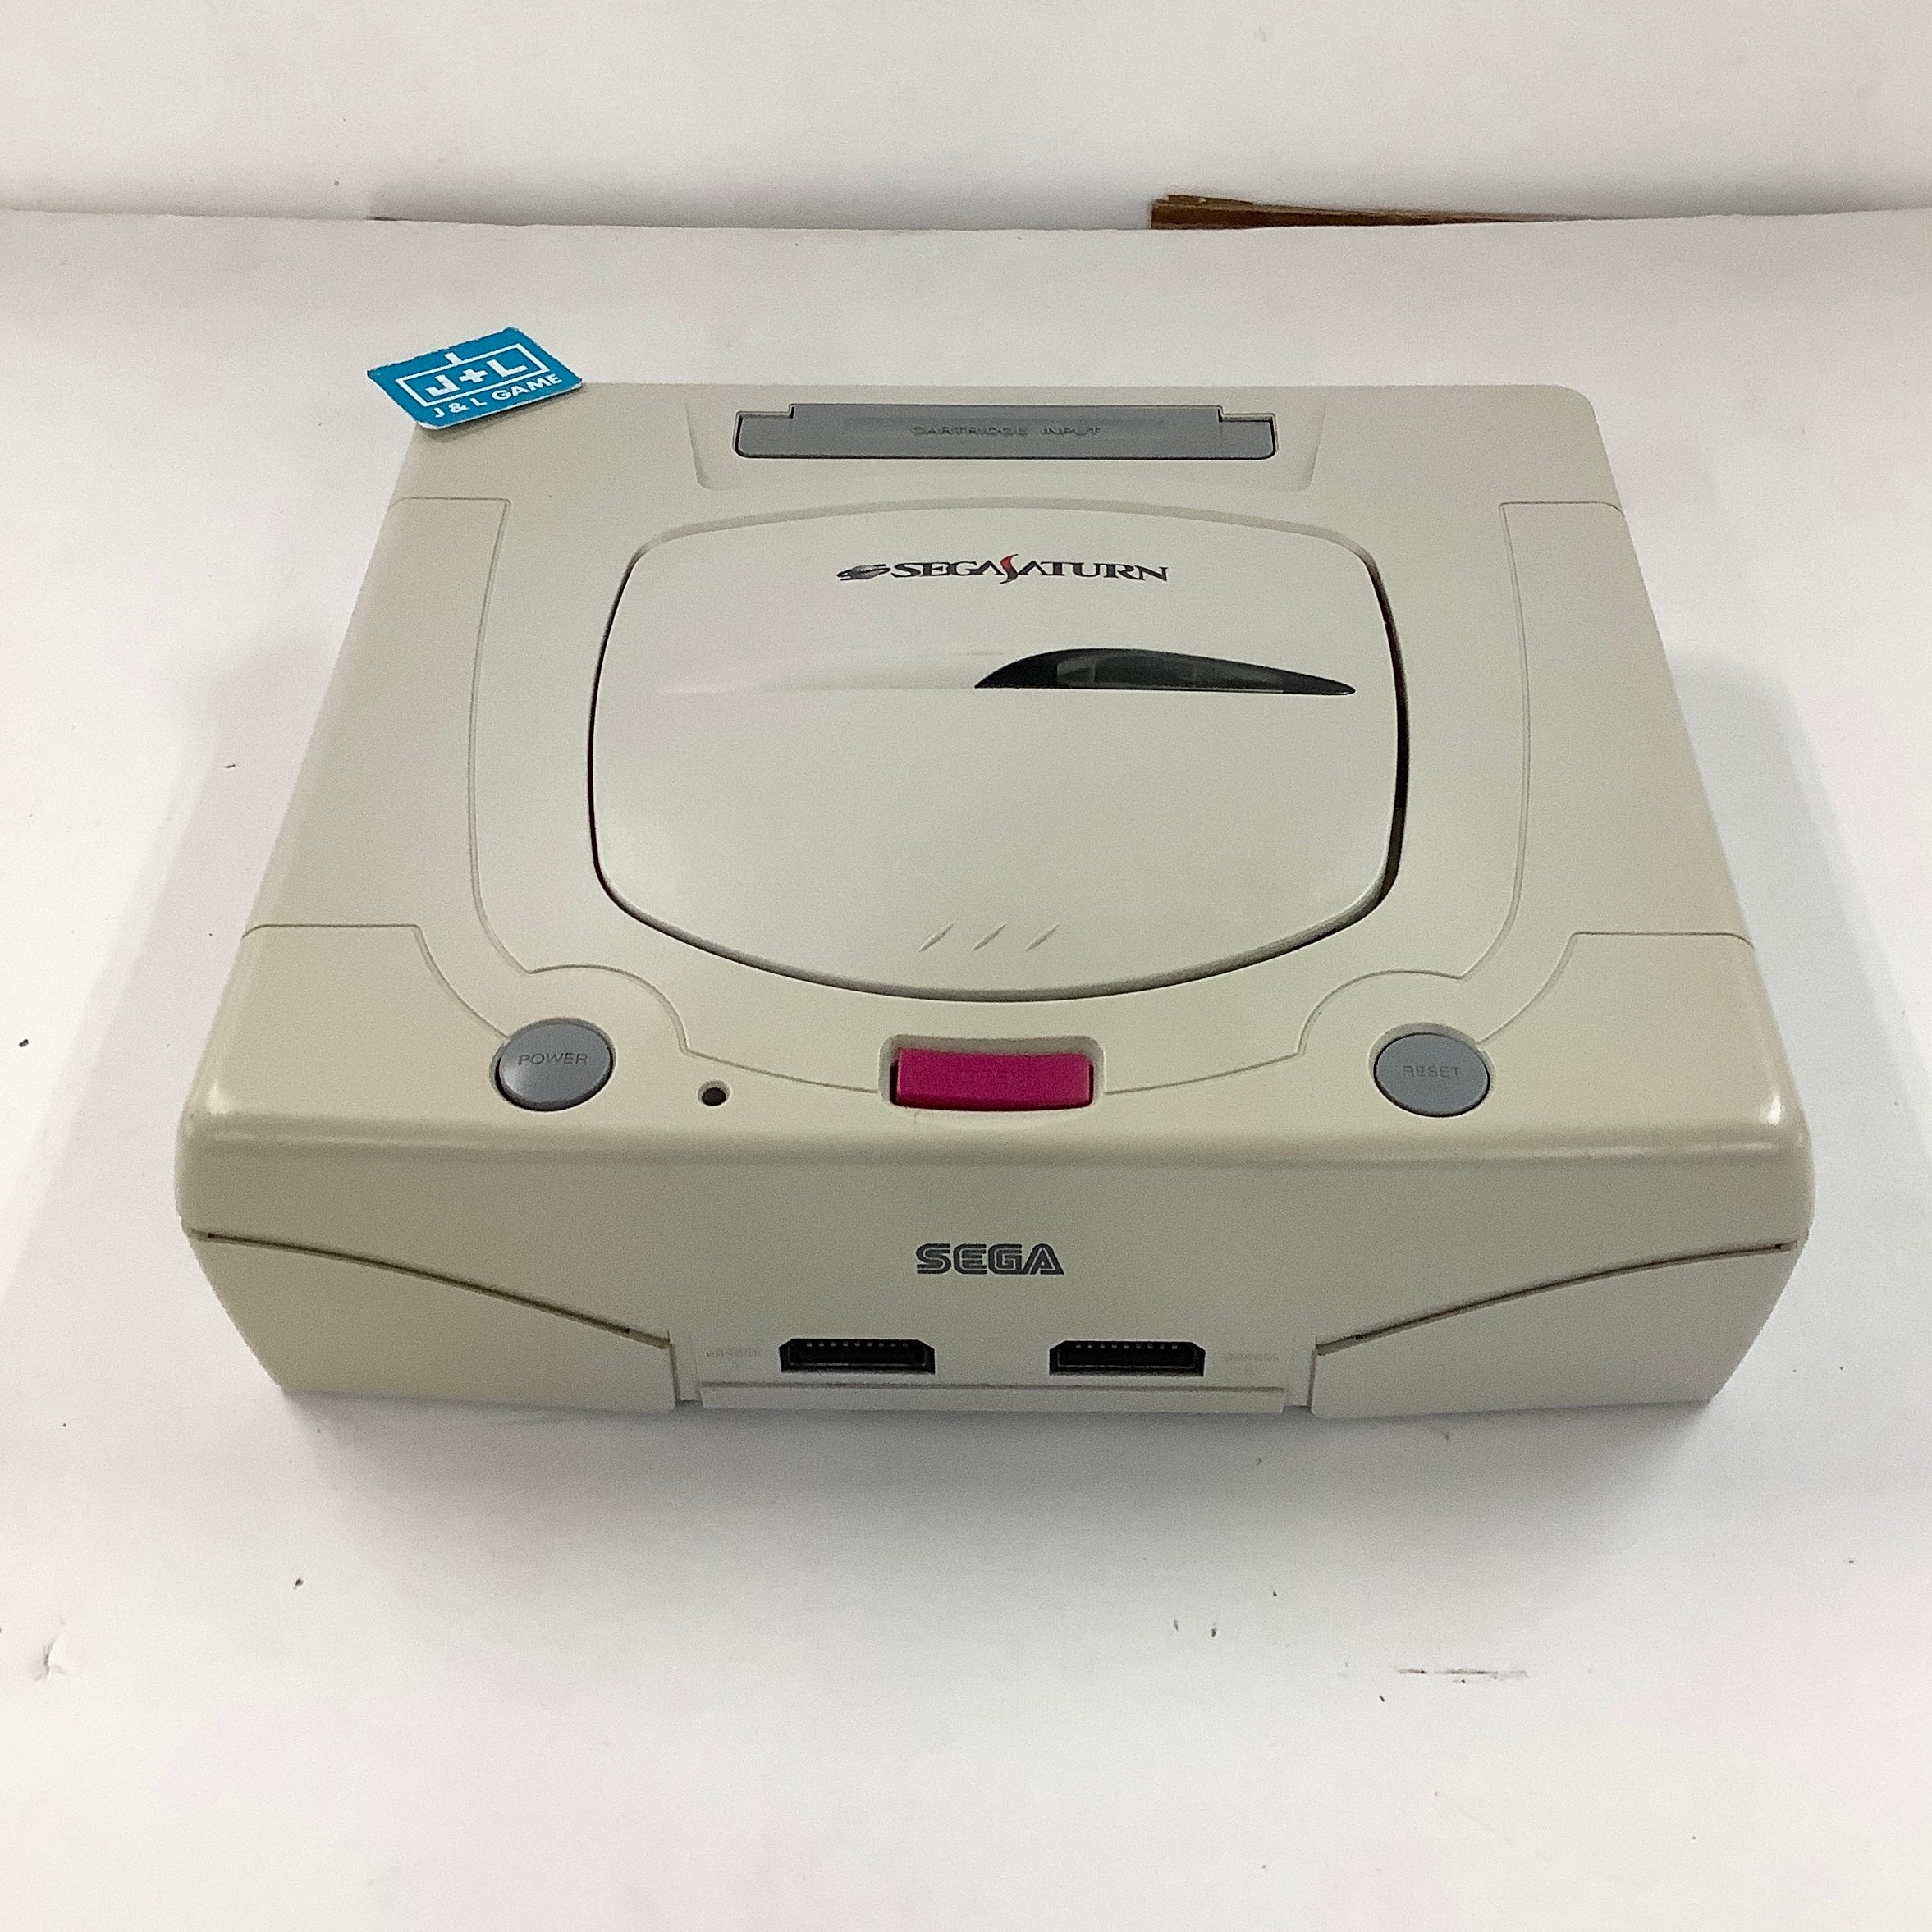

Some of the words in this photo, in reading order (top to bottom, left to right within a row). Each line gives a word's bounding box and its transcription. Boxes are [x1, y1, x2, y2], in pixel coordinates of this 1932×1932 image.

[433, 407, 446, 418] J
[448, 402, 471, 414] &
[469, 397, 488, 407] L
[491, 373, 563, 401] GAME
[912, 425, 1028, 437] CARTRIDGE
[1041, 425, 1101, 437] INPUT
[517, 1052, 588, 1066] POWER
[1402, 1065, 1459, 1078] RESET
[915, 1243, 1064, 1275] SEGA
